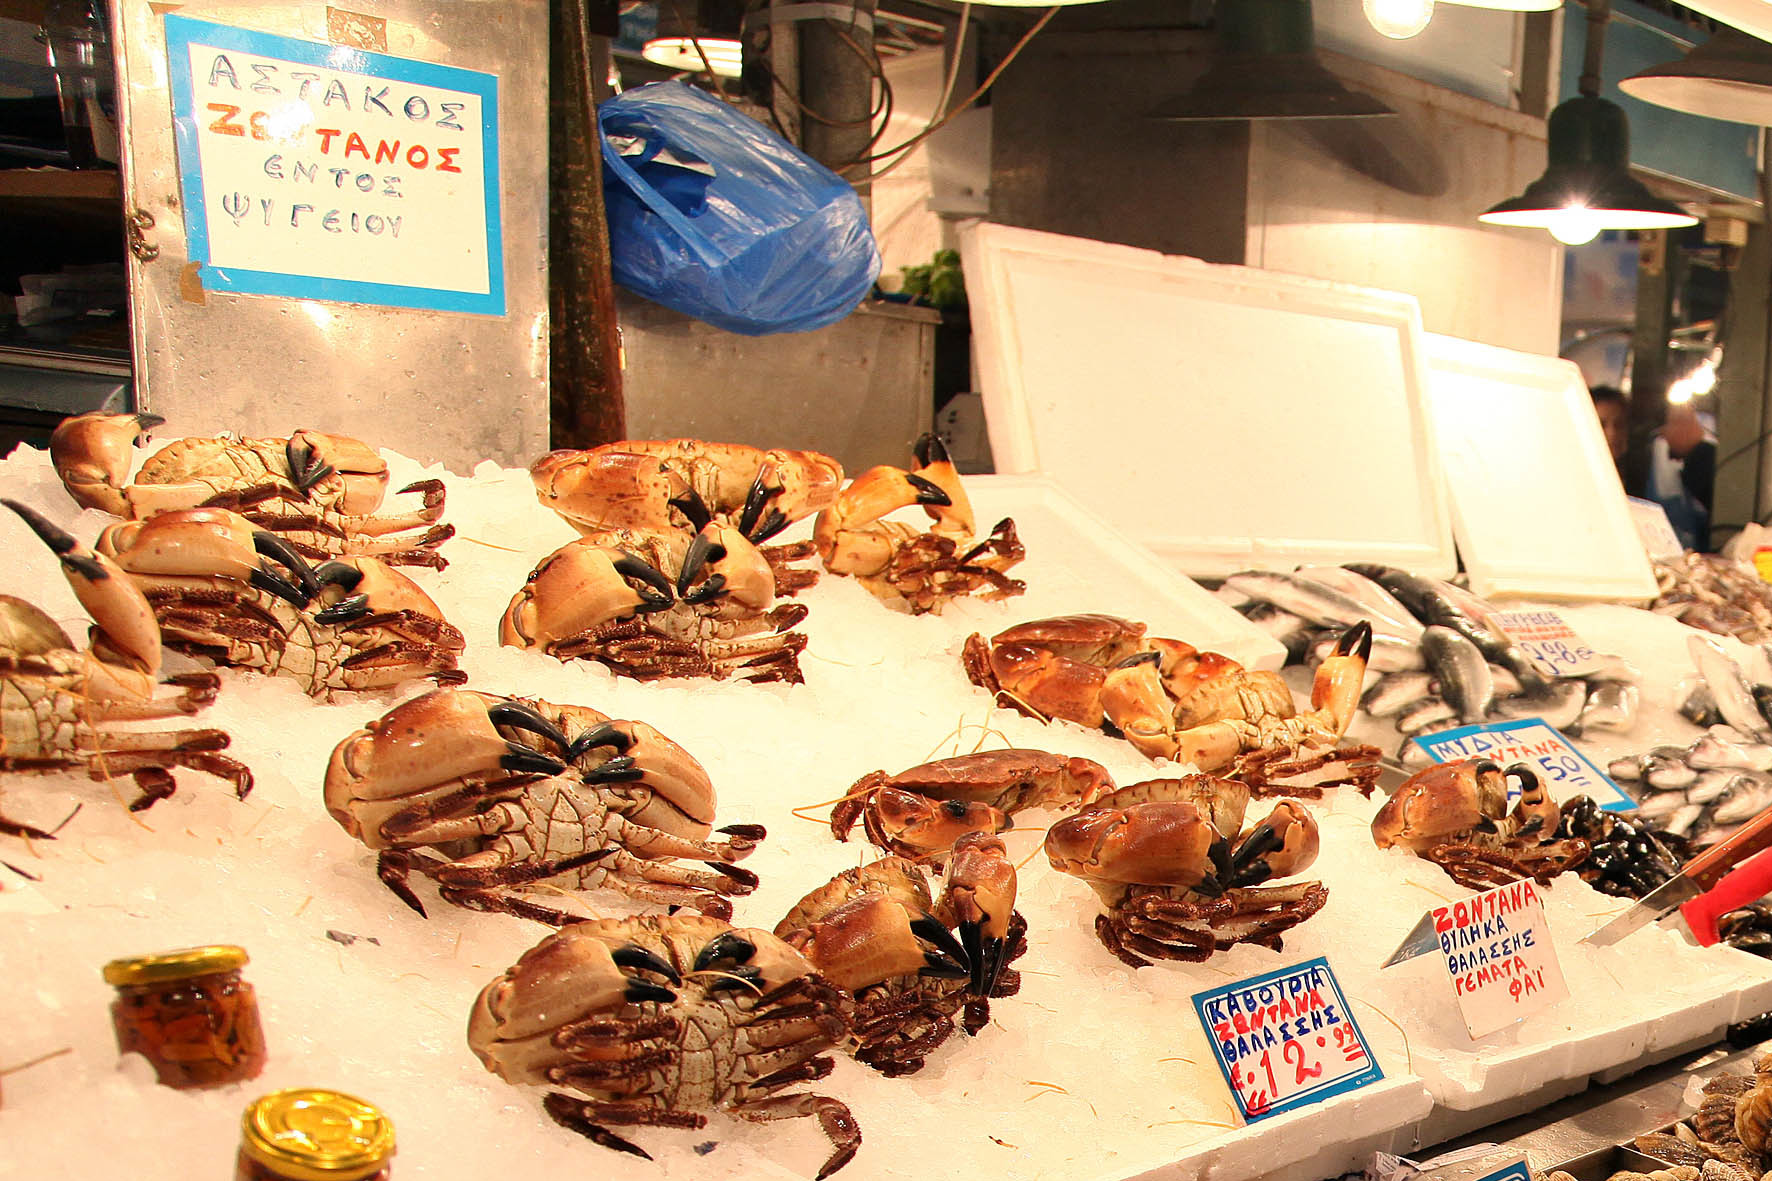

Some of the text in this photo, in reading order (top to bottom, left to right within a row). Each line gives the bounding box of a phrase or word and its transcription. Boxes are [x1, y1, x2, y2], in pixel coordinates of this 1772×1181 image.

[208, 54, 465, 131] ΑΣΤΑΚΟΣ
[206, 102, 462, 173] ΖΩΤΑΝΟΣ
[263, 154, 404, 198] ΕΝΤΟΣ
[222, 191, 404, 239] ΨΥΓΕΙΟΥ
[1436, 730, 1521, 760] ΜΥΔΙΑ
[1453, 739, 1568, 767] ΝΤΑΝΑ
[1433, 881, 1538, 933] ΖΩΝΤΑΝΑ
[1440, 914, 1509, 954] ΘΥΛΗΚΑ
[1448, 928, 1536, 975] ΘΑΛΑΣΣΗΣ
[1208, 967, 1324, 1024] ΚΑΒΟΥΡΙΑ
[1455, 955, 1528, 996] ΓΕΜΑΤΑ
[1215, 988, 1325, 1041] ΖΩΝΤΑΝΑ
[1222, 1005, 1340, 1062] ΘΑΛΑΣΣΗΣ
